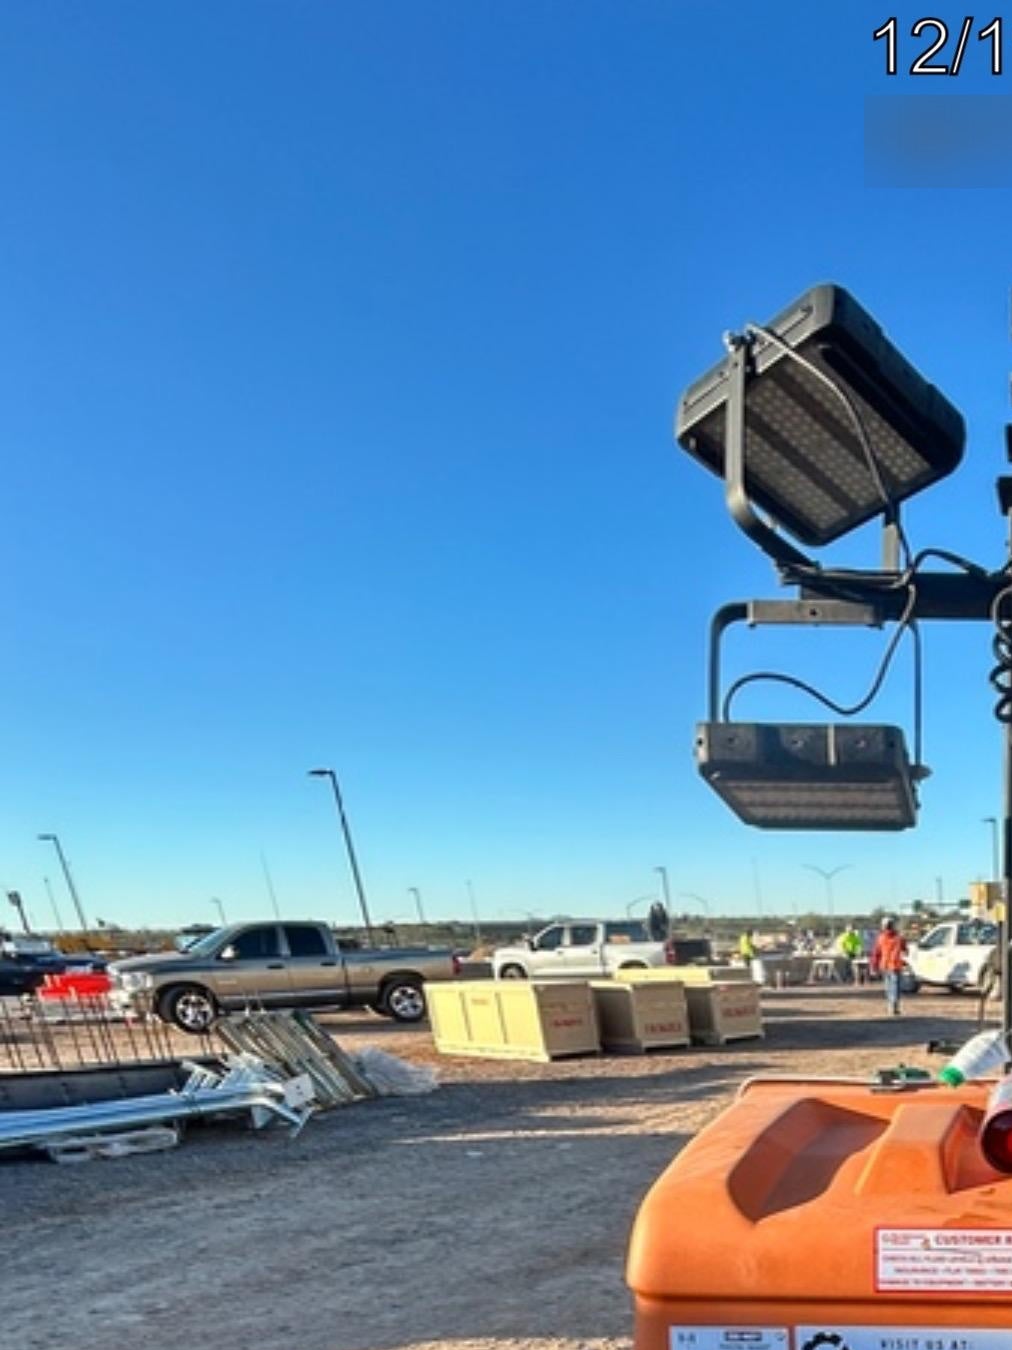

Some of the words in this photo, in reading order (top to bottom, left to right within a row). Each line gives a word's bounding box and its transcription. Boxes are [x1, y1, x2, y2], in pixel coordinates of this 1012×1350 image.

[935, 1234, 1001, 1246] CUSTOMER
[881, 1338, 919, 1350] VISIT
[926, 1339, 944, 1350] US
